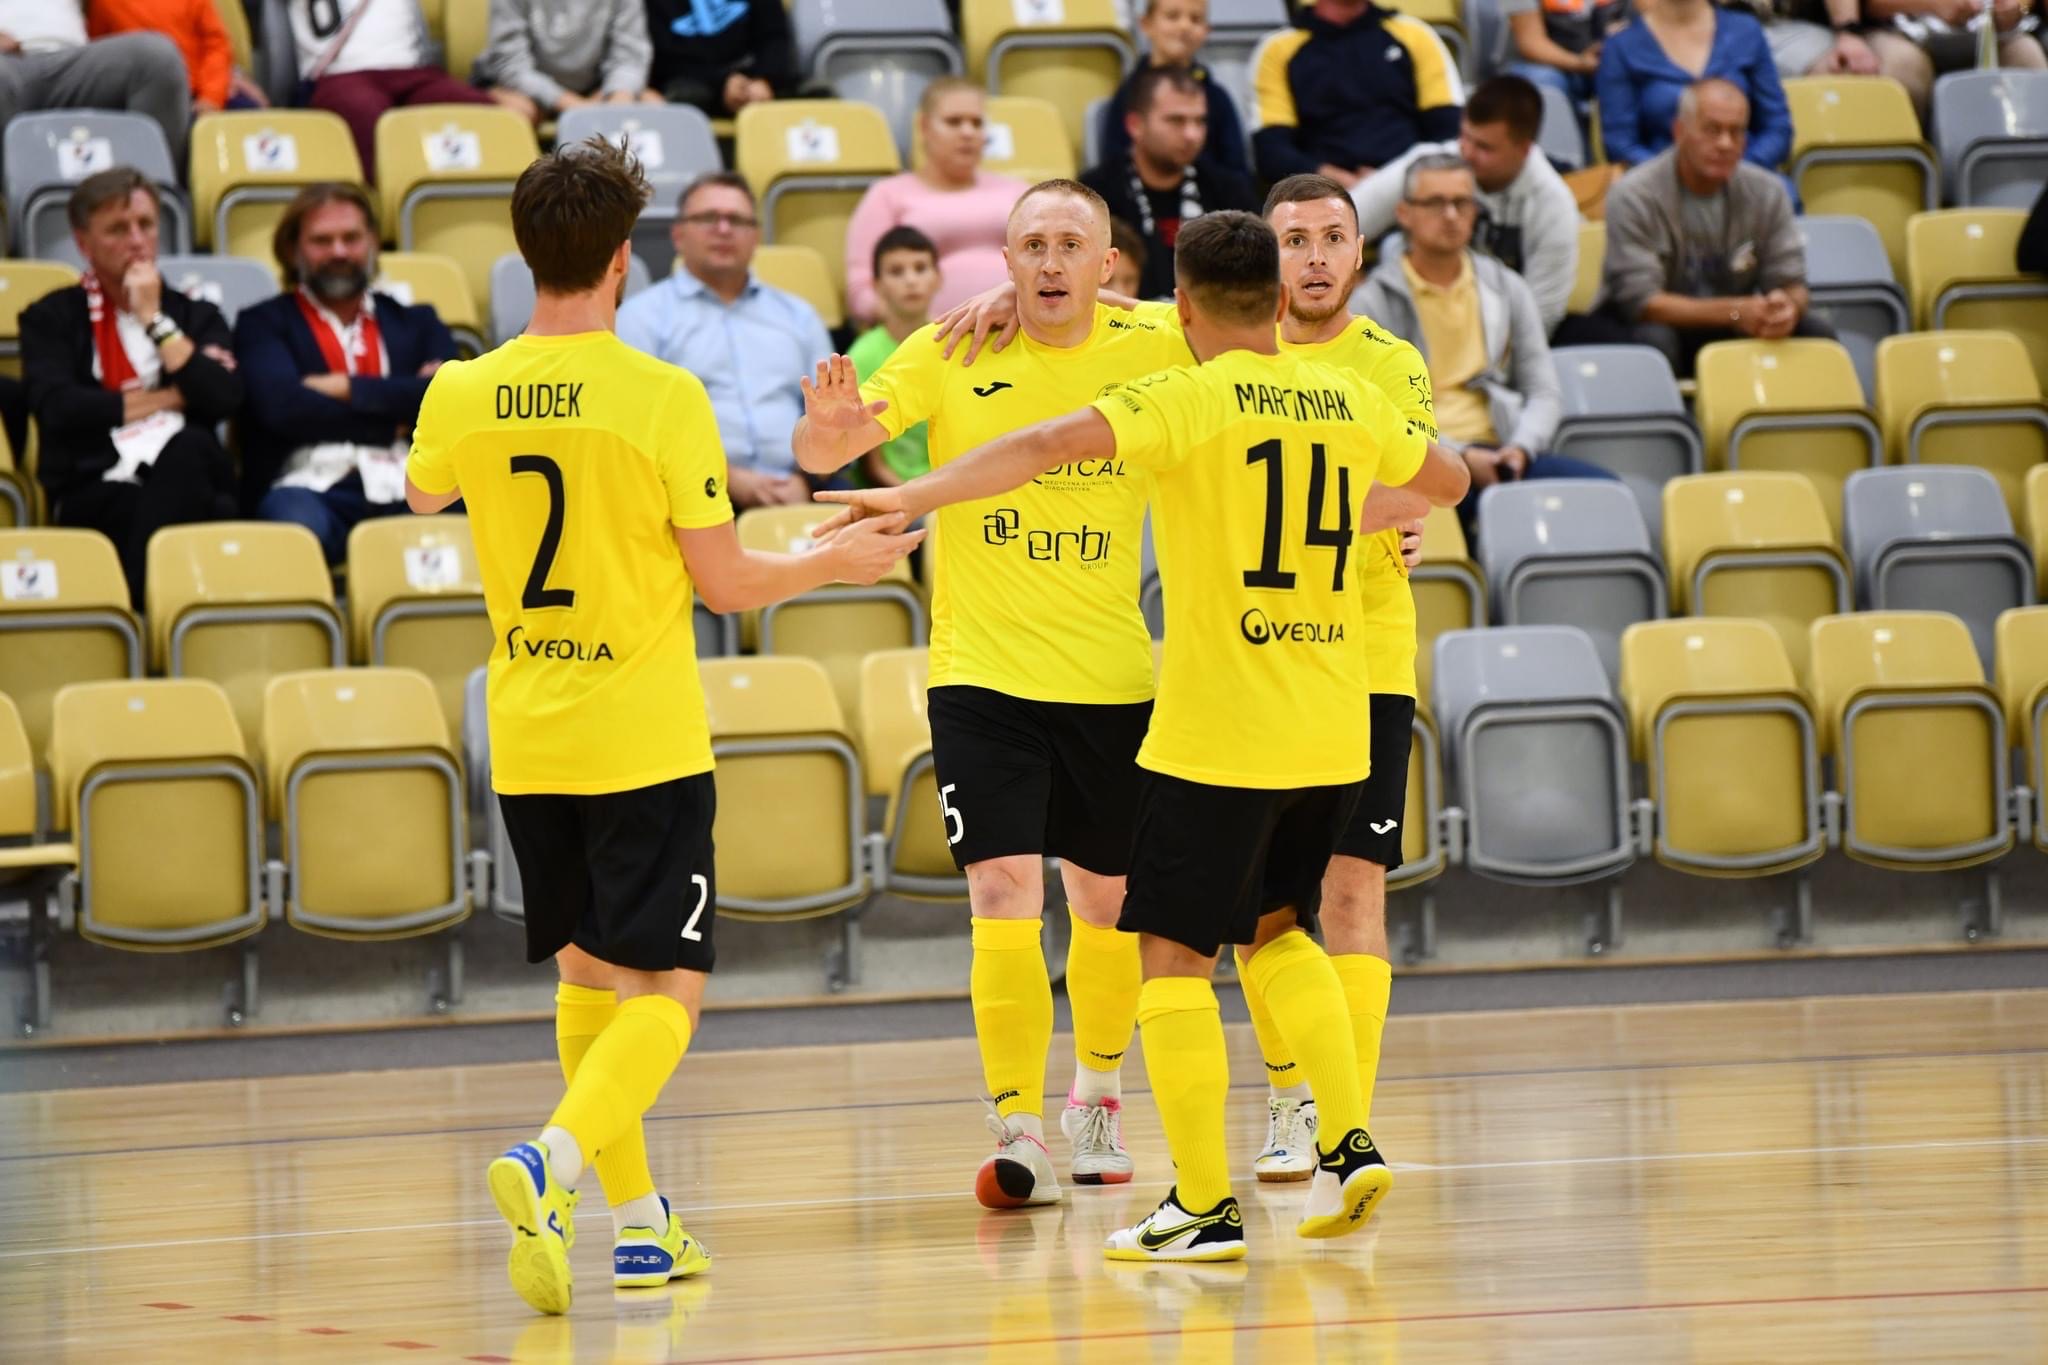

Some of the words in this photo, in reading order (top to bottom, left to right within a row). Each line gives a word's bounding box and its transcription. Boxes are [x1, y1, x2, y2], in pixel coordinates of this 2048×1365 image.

[496, 382, 584, 419] DUDEK
[1044, 459, 1125, 477] DICAL
[510, 454, 575, 609] 2
[1243, 438, 1353, 592] 14
[1080, 561, 1109, 570] GROUP
[523, 638, 614, 662] VEOLIA
[1270, 621, 1344, 643] VEOLIA
[938, 783, 964, 847] 5
[680, 873, 708, 942] 2
